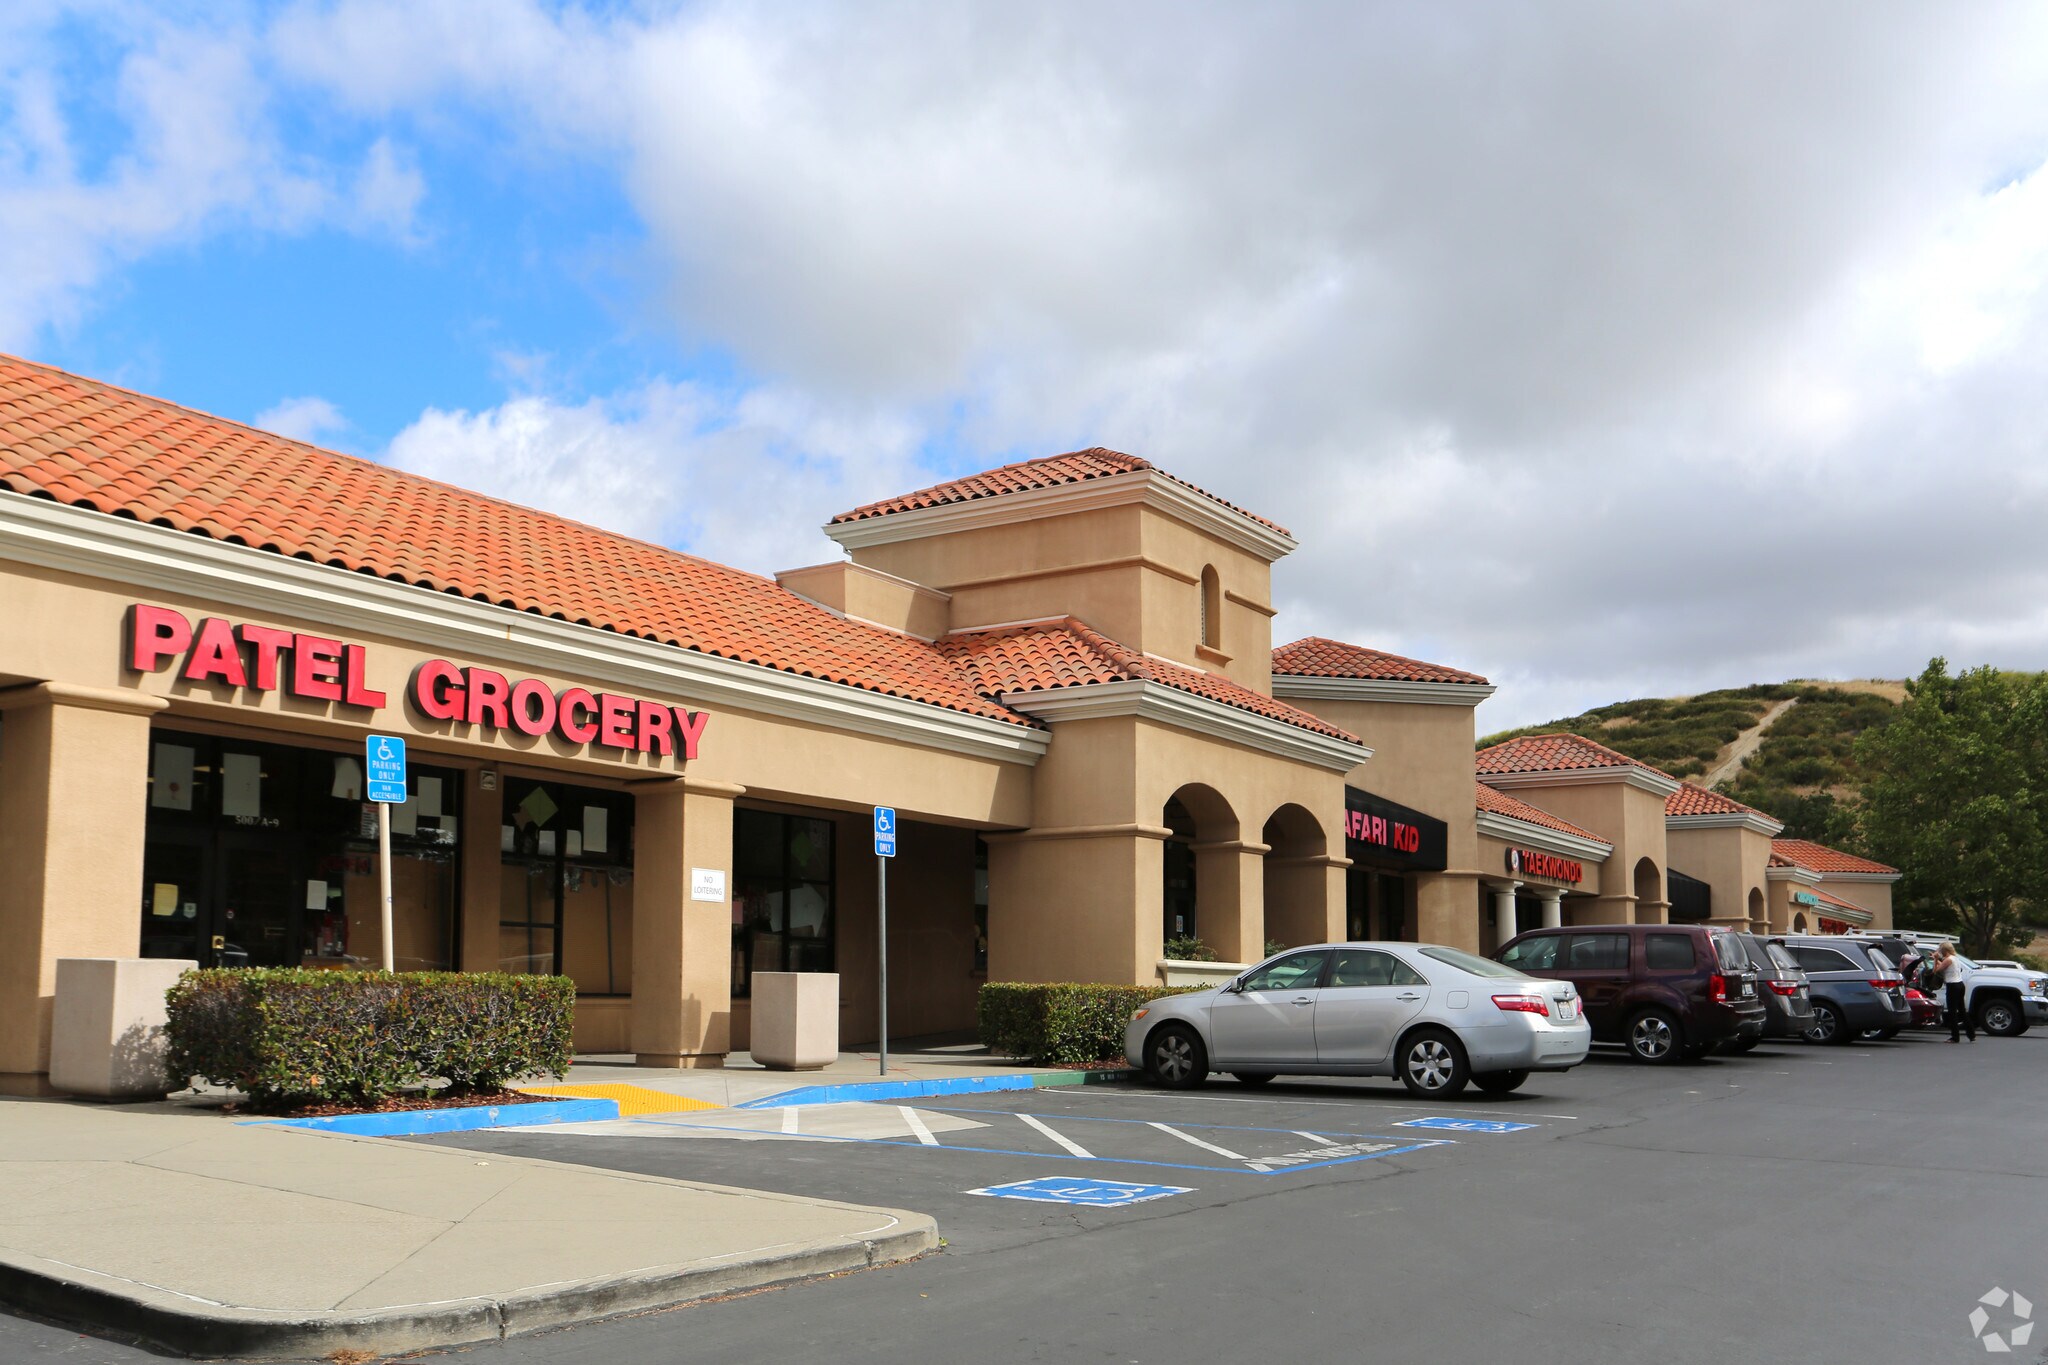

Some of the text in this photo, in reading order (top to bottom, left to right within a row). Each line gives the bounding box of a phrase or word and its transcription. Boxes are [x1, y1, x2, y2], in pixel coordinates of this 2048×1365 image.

[130, 604, 710, 760] PATEL GROCERY
[372, 760, 401, 771] PARKING
[378, 770, 396, 781] ONLY
[381, 784, 392, 792] VAN
[371, 791, 402, 801] ACCESSIBLE
[876, 832, 894, 842] PARKING
[1393, 821, 1420, 853] KID
[1521, 849, 1583, 883] TAEKWONDO
[703, 875, 714, 884] NO
[693, 885, 723, 896] LOITERING
